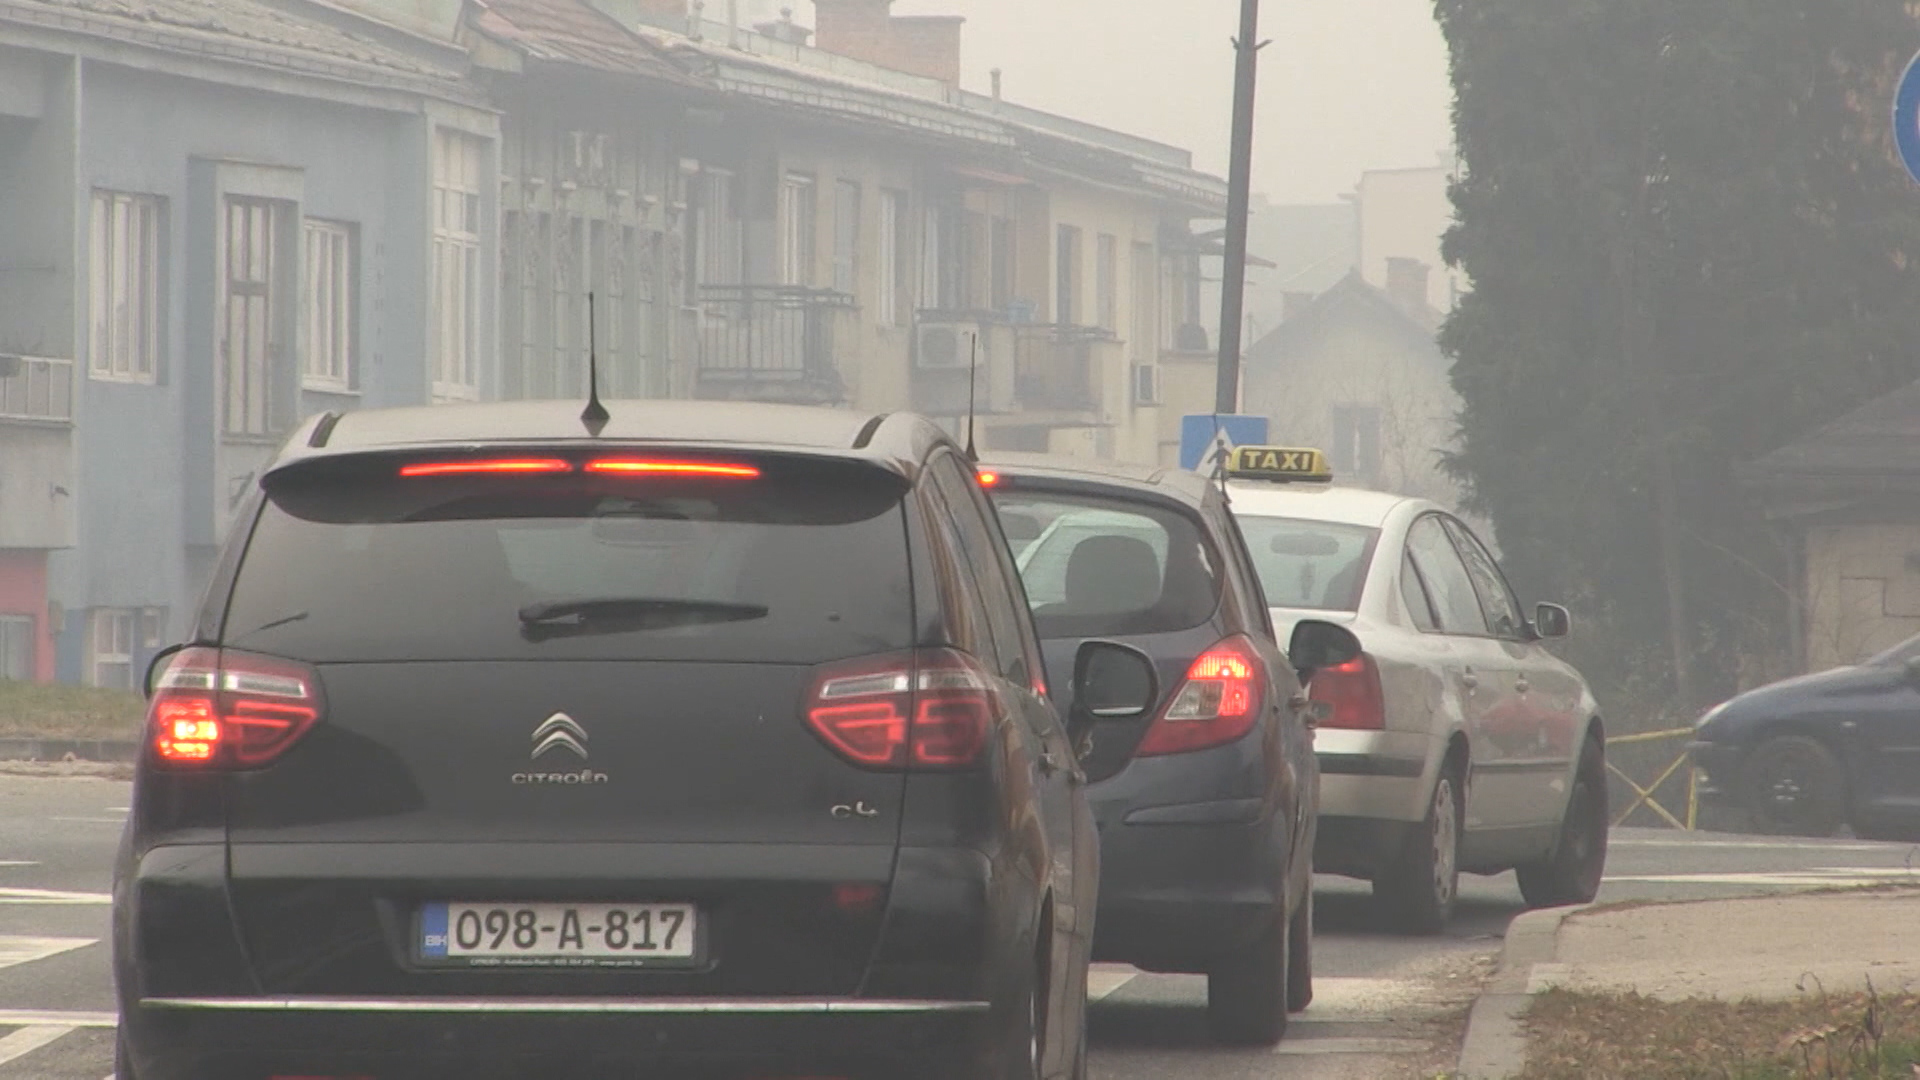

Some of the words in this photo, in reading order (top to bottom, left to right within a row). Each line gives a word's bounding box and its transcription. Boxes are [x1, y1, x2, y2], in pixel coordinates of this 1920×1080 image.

[1244, 450, 1310, 470] TAXI
[456, 909, 685, 950] 098-A-817
[424, 935, 448, 946] BIH
